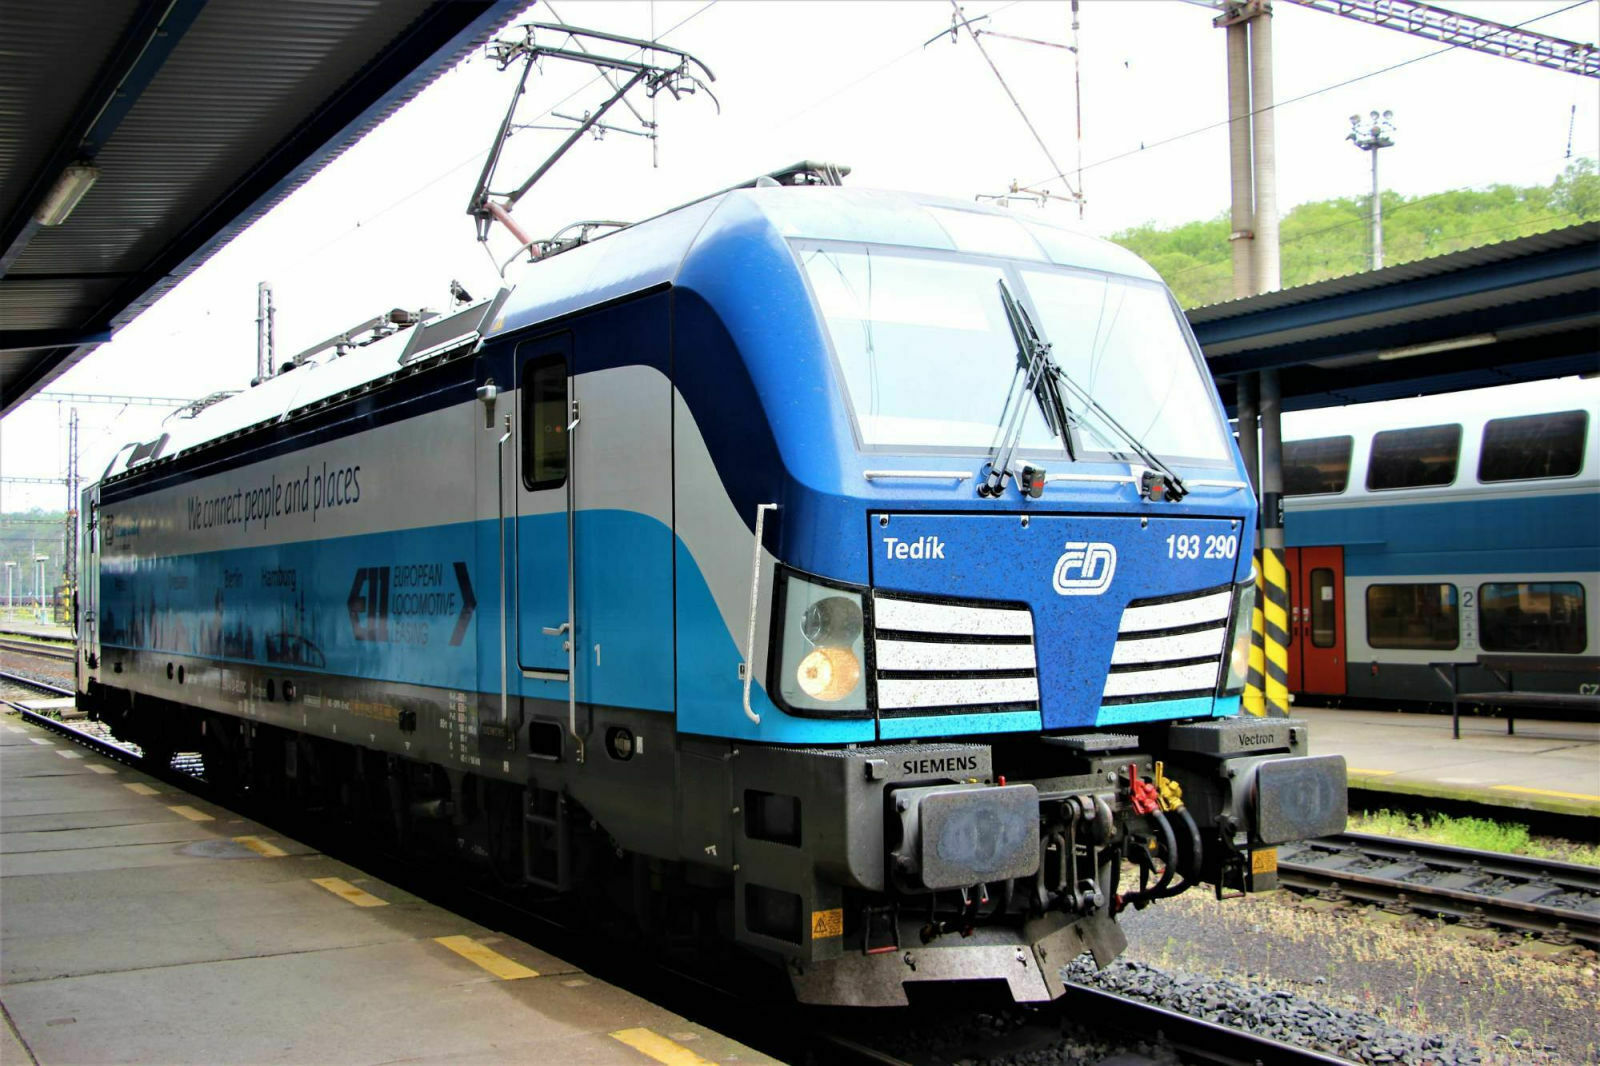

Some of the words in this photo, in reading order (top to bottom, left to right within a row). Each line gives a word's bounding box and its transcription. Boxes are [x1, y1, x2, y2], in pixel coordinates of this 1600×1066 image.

[187, 496, 202, 530] We
[203, 488, 242, 529] connect
[244, 474, 282, 532] people
[285, 465, 310, 514] and
[313, 461, 361, 523] places
[883, 535, 945, 559] Tedík
[1166, 534, 1200, 559] 193
[1203, 535, 1237, 559] 290
[393, 563, 443, 588] EUROPEAN
[391, 592, 456, 617] LOCOMOTIVE
[1463, 592, 1474, 608] 2
[391, 621, 429, 645] LEASING
[594, 643, 601, 666] 1
[1238, 731, 1274, 747] Vectron
[903, 756, 978, 775] SIEMENS
